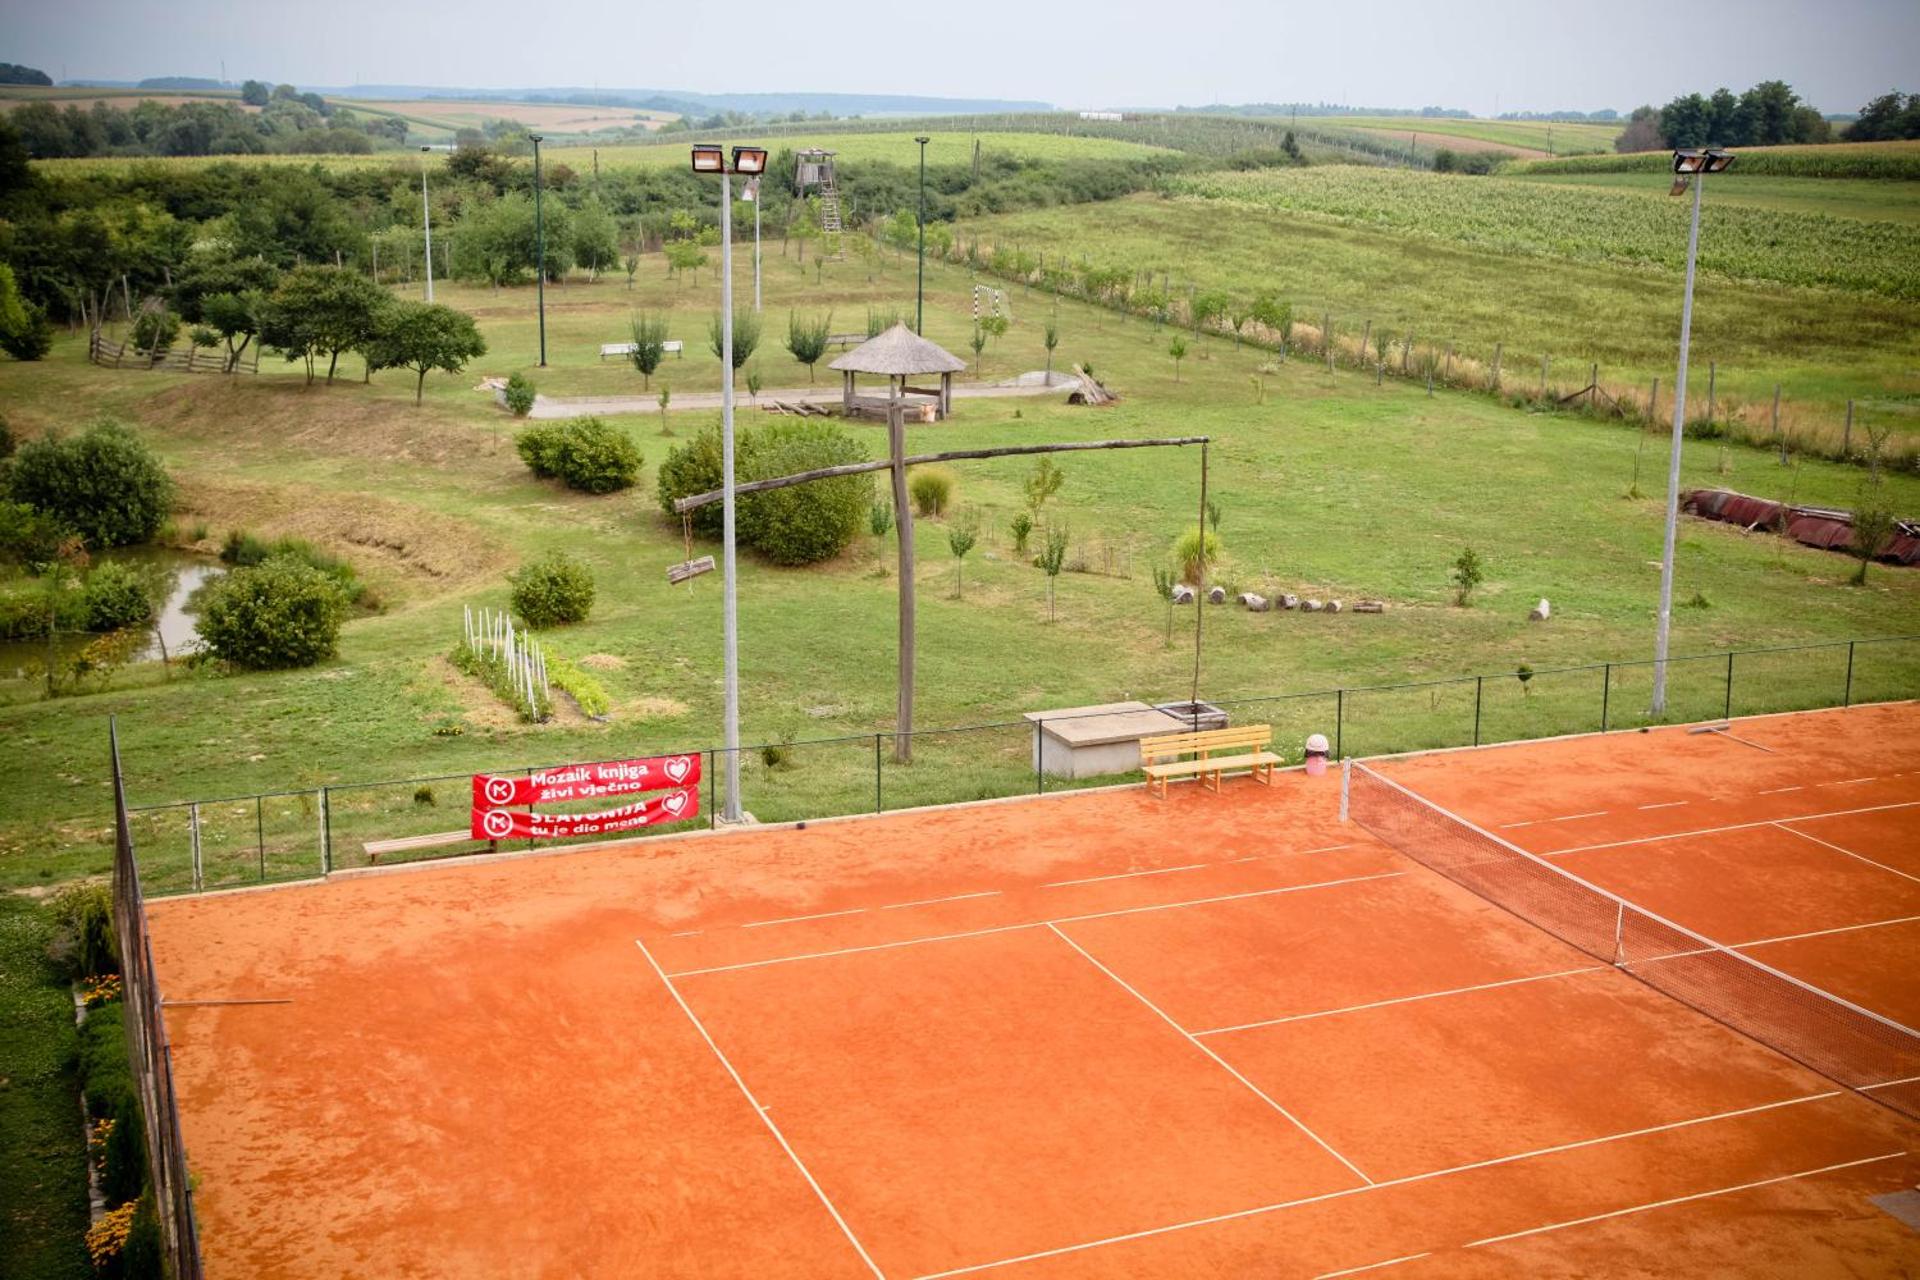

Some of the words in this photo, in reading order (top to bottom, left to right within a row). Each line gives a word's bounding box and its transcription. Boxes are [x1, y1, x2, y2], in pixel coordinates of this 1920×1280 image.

[531, 767, 591, 787] Mozaik
[597, 764, 649, 780] knjiga
[540, 786, 573, 799] živi
[578, 781, 641, 796] vječno
[530, 826, 548, 835] tu
[553, 825, 568, 837] je
[573, 823, 599, 834] dio
[604, 816, 648, 830] mene
